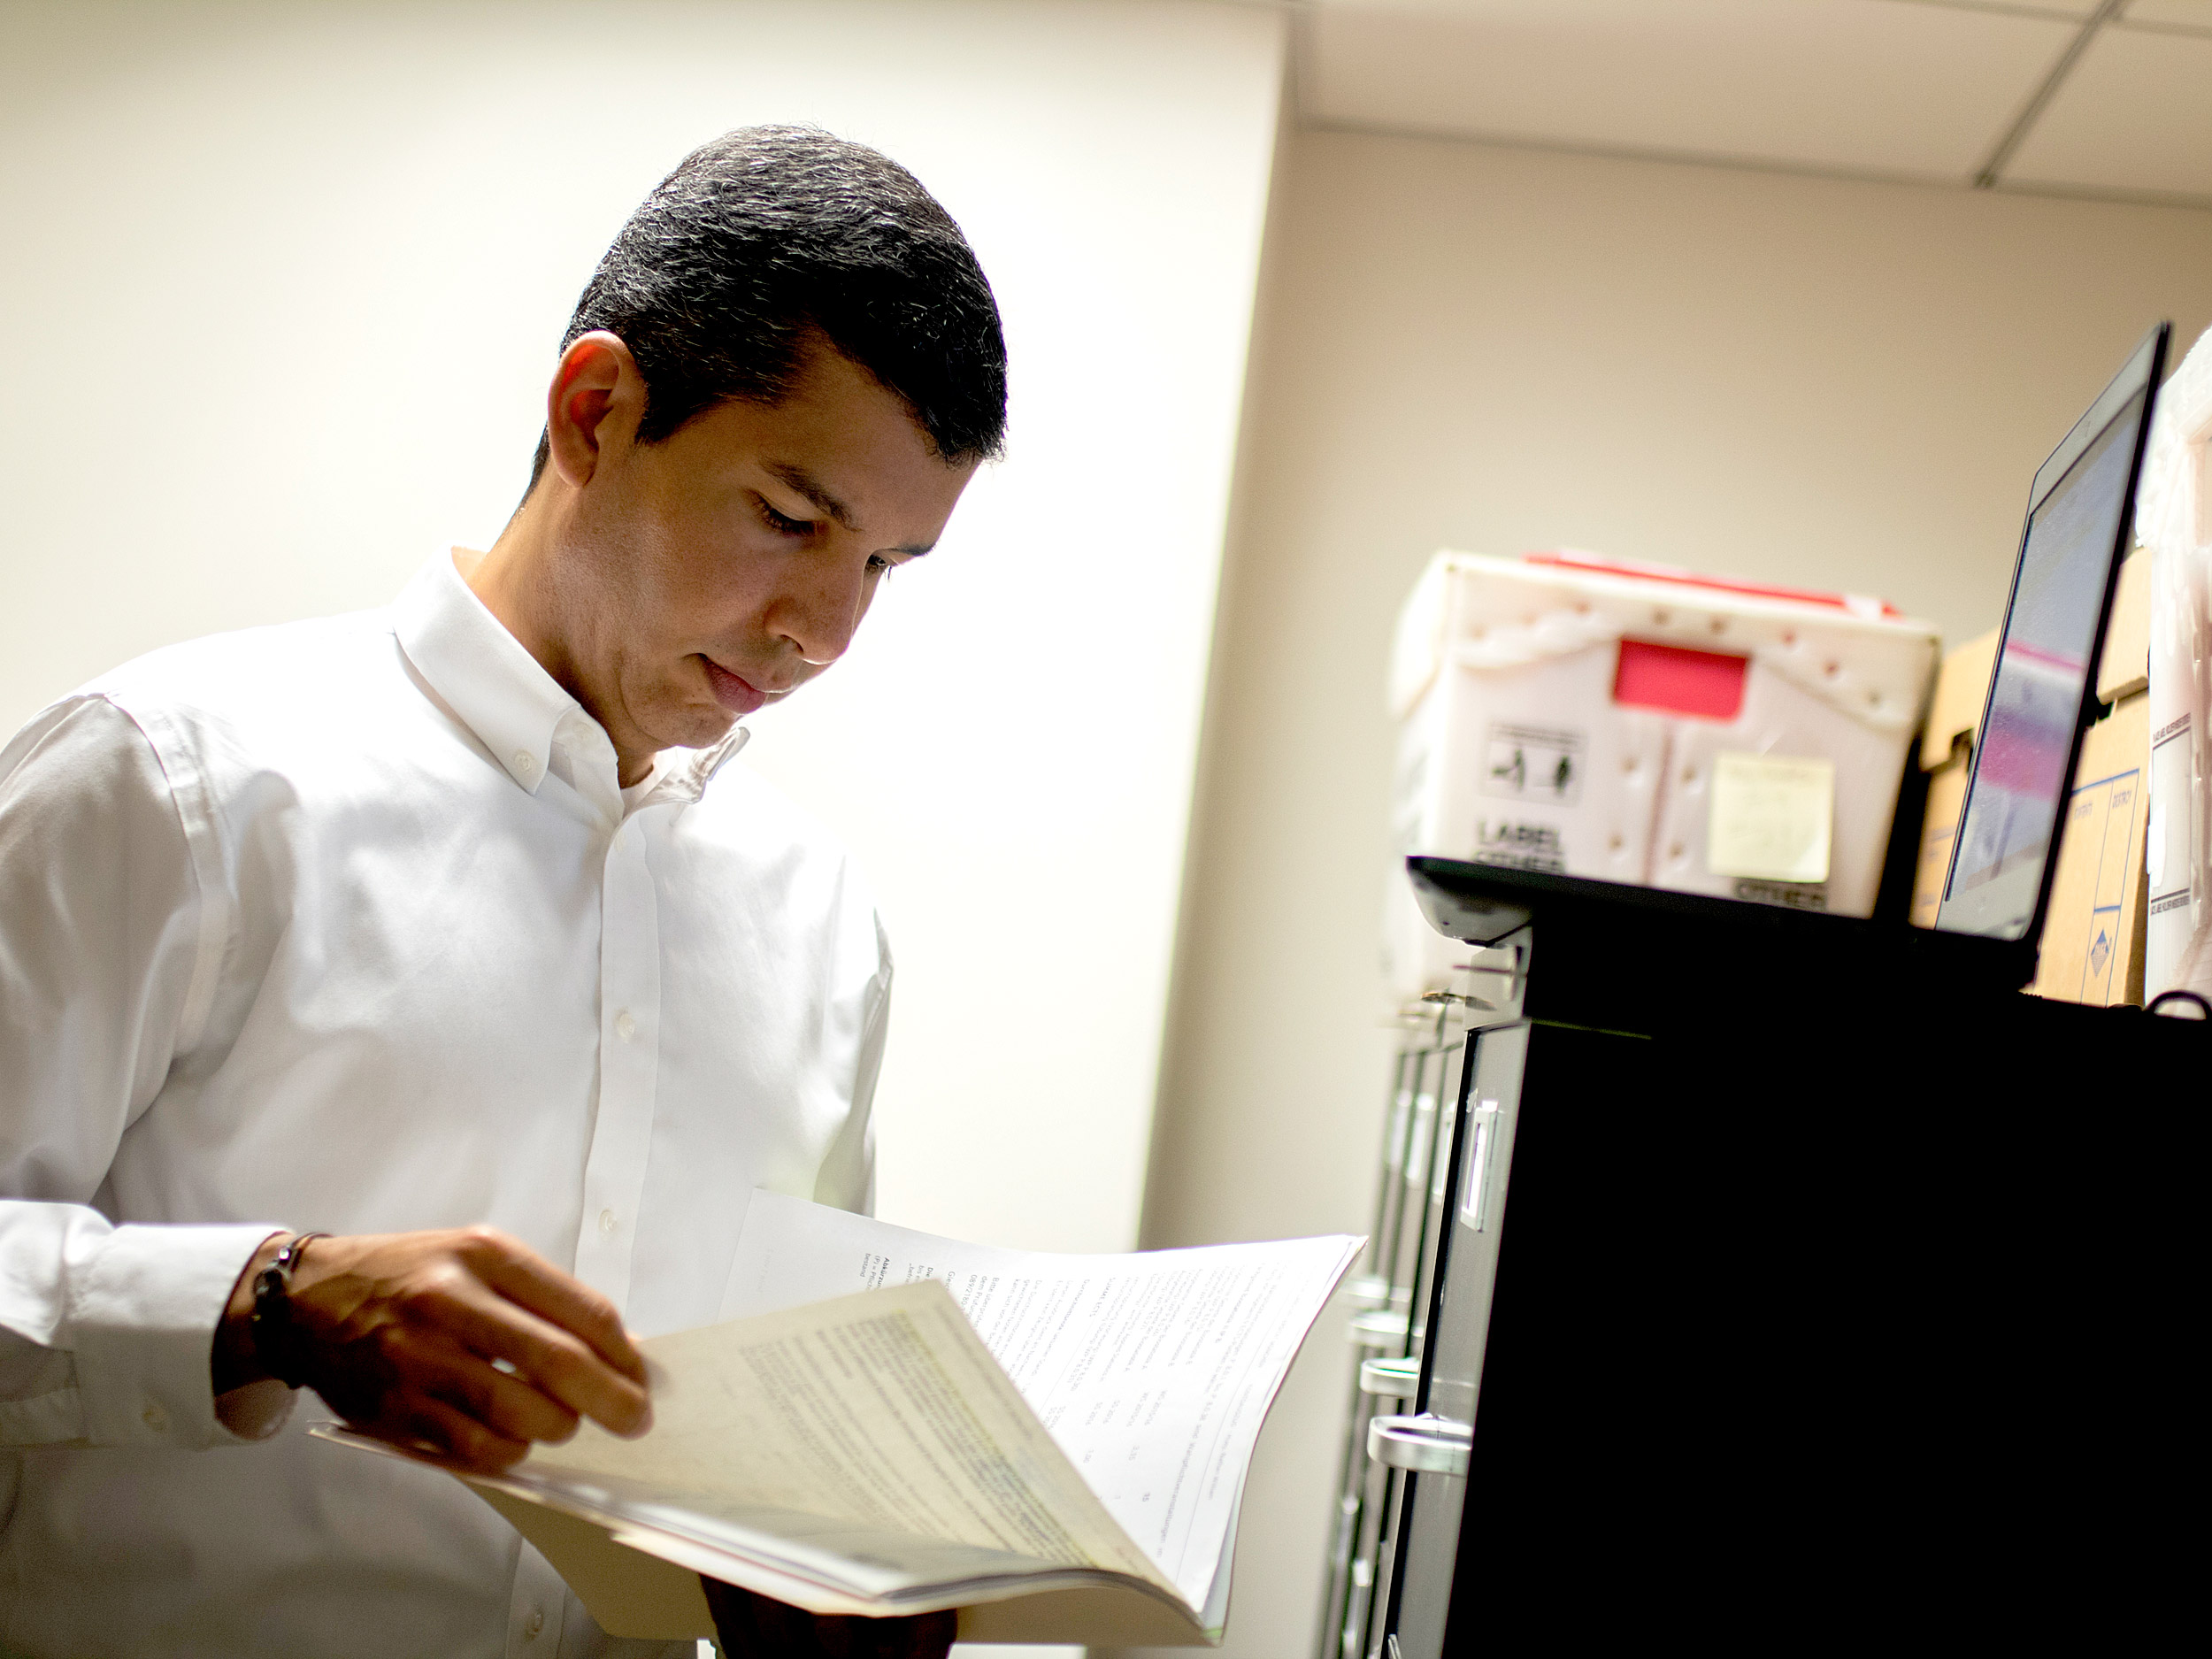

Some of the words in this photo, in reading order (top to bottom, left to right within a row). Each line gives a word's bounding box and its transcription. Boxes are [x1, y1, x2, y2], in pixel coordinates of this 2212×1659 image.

[1478, 818, 1561, 851] LABEL
[859, 1253, 872, 1278] bestand
[977, 1275, 987, 1291] dem
[988, 1277, 999, 1293] Bitte
[1010, 1279, 1021, 1293] kann
[1099, 1277, 1117, 1300] SUMME
[1003, 1294, 1012, 1307] sich
[1011, 1279, 1030, 1316] gewichteten
[973, 1293, 992, 1328] überprüfen
[1008, 1291, 1037, 1343] Durchschnittsnote
[1089, 1302, 1102, 1317] ECTS
[1002, 1317, 1015, 1334] Noten
[1160, 1441, 1196, 1543] Wahlpflichtveranstaltungen
